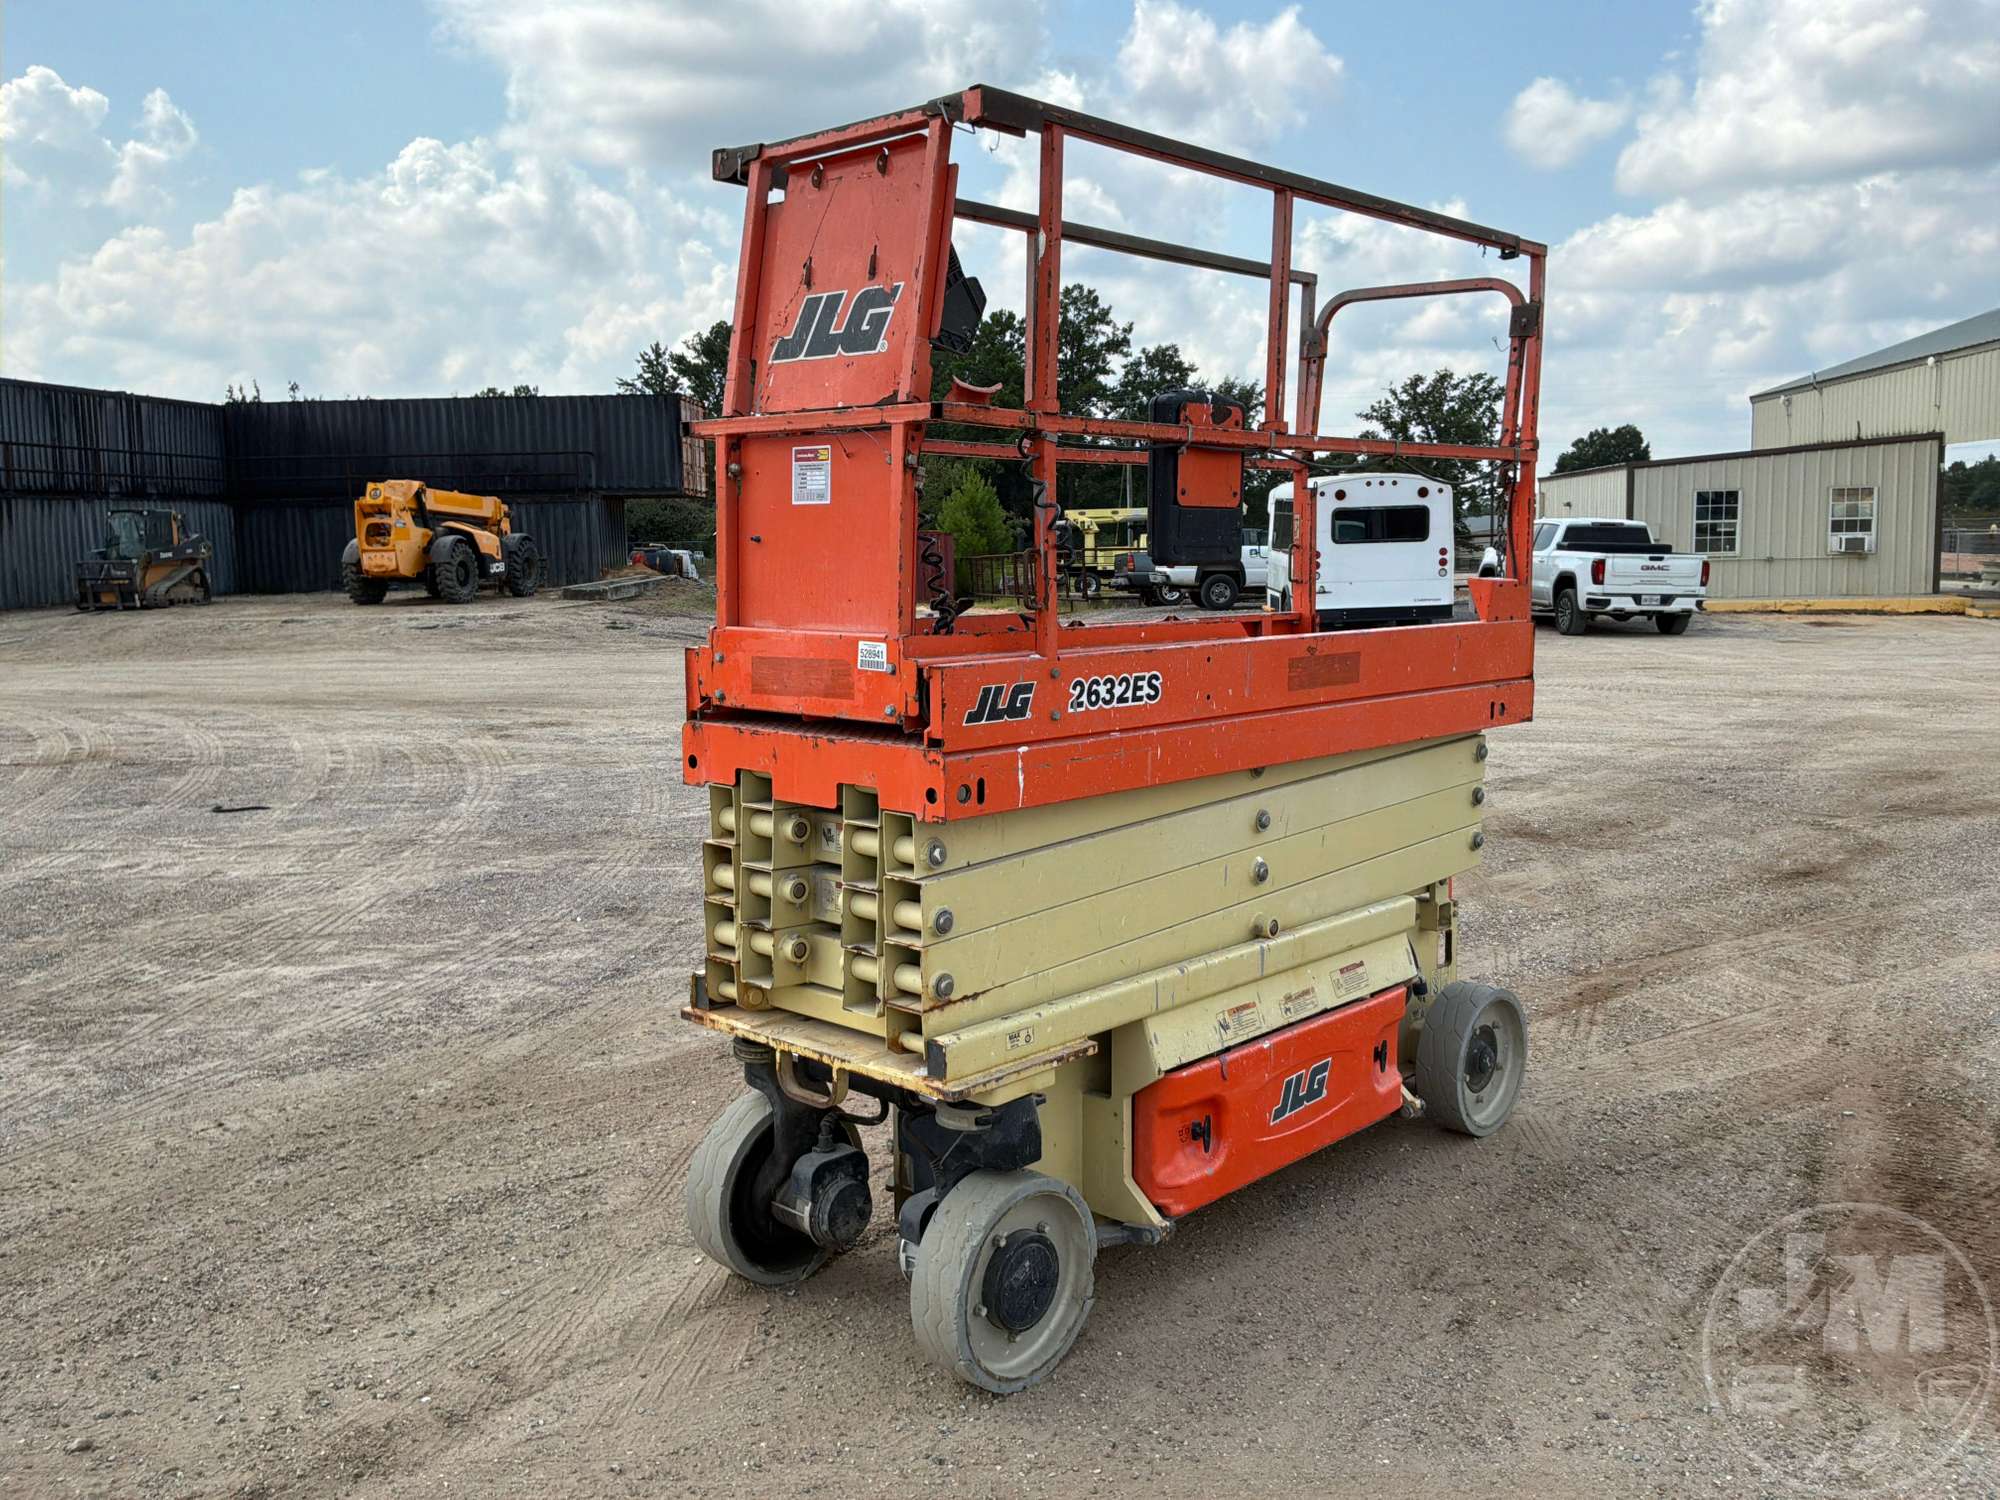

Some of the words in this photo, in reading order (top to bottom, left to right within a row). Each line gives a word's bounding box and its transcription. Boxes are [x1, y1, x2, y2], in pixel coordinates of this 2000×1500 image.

[768, 281, 904, 364] JLG
[489, 562, 505, 573] JCB
[860, 648, 884, 660] 528941
[963, 681, 1037, 726] JLG
[1068, 671, 1163, 712] 2632ES
[1270, 1057, 1332, 1125] JLG
